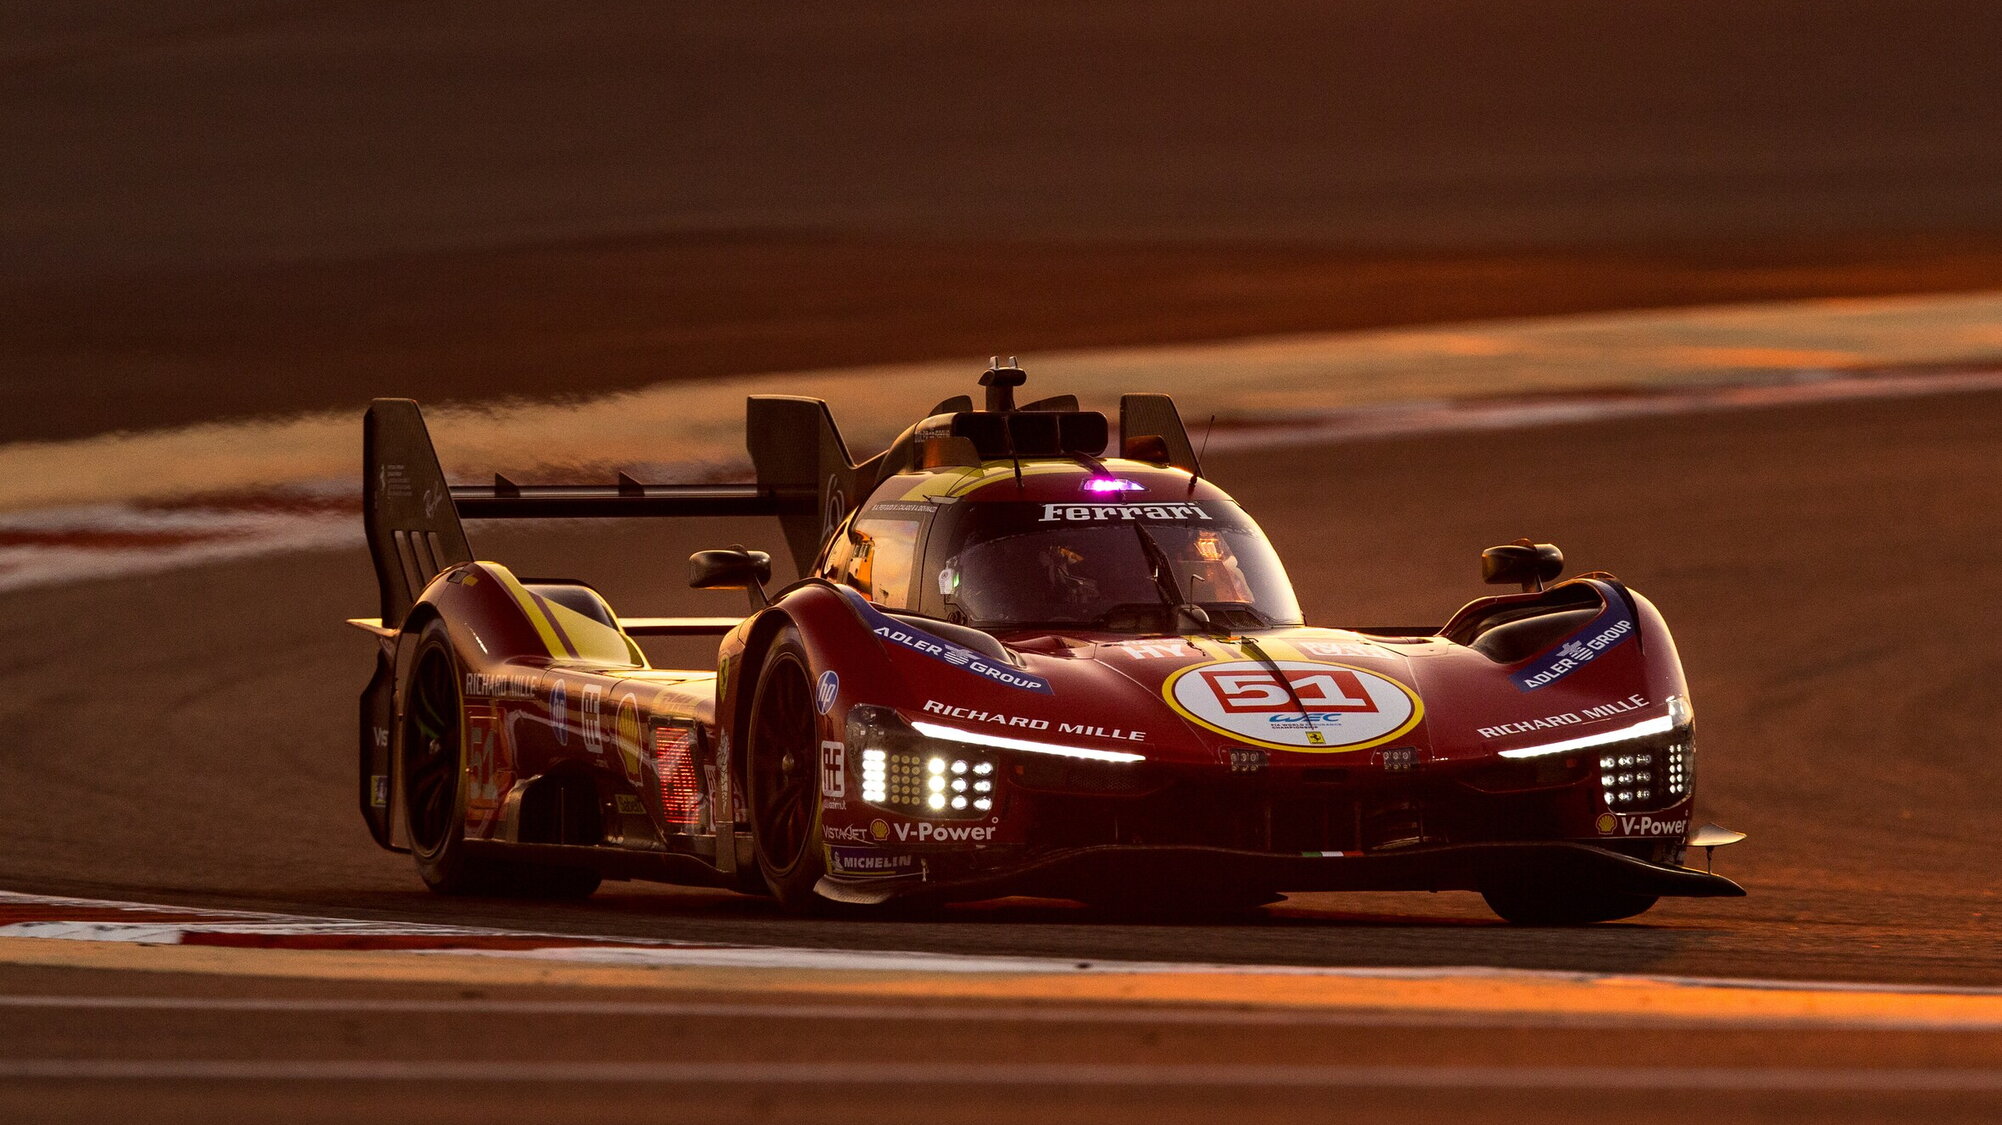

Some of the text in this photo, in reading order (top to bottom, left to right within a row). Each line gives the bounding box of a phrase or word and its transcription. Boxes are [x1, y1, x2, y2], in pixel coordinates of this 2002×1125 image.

[1038, 503, 1213, 521] Ferrari
[874, 627, 1042, 690] ADLER GROUP
[1524, 620, 1632, 689] ADLER GROUP
[466, 673, 537, 697] RICHARD MILLE
[818, 671, 838, 714] hp
[1213, 675, 1367, 707] 51
[923, 700, 1147, 742] RICHARD MILLE
[1269, 713, 1342, 722] WEC
[1477, 694, 1650, 738] RICHARD MILLE
[893, 822, 996, 842] V-Power
[1621, 816, 1687, 836] V-Power
[843, 855, 912, 869] MICHELIN
